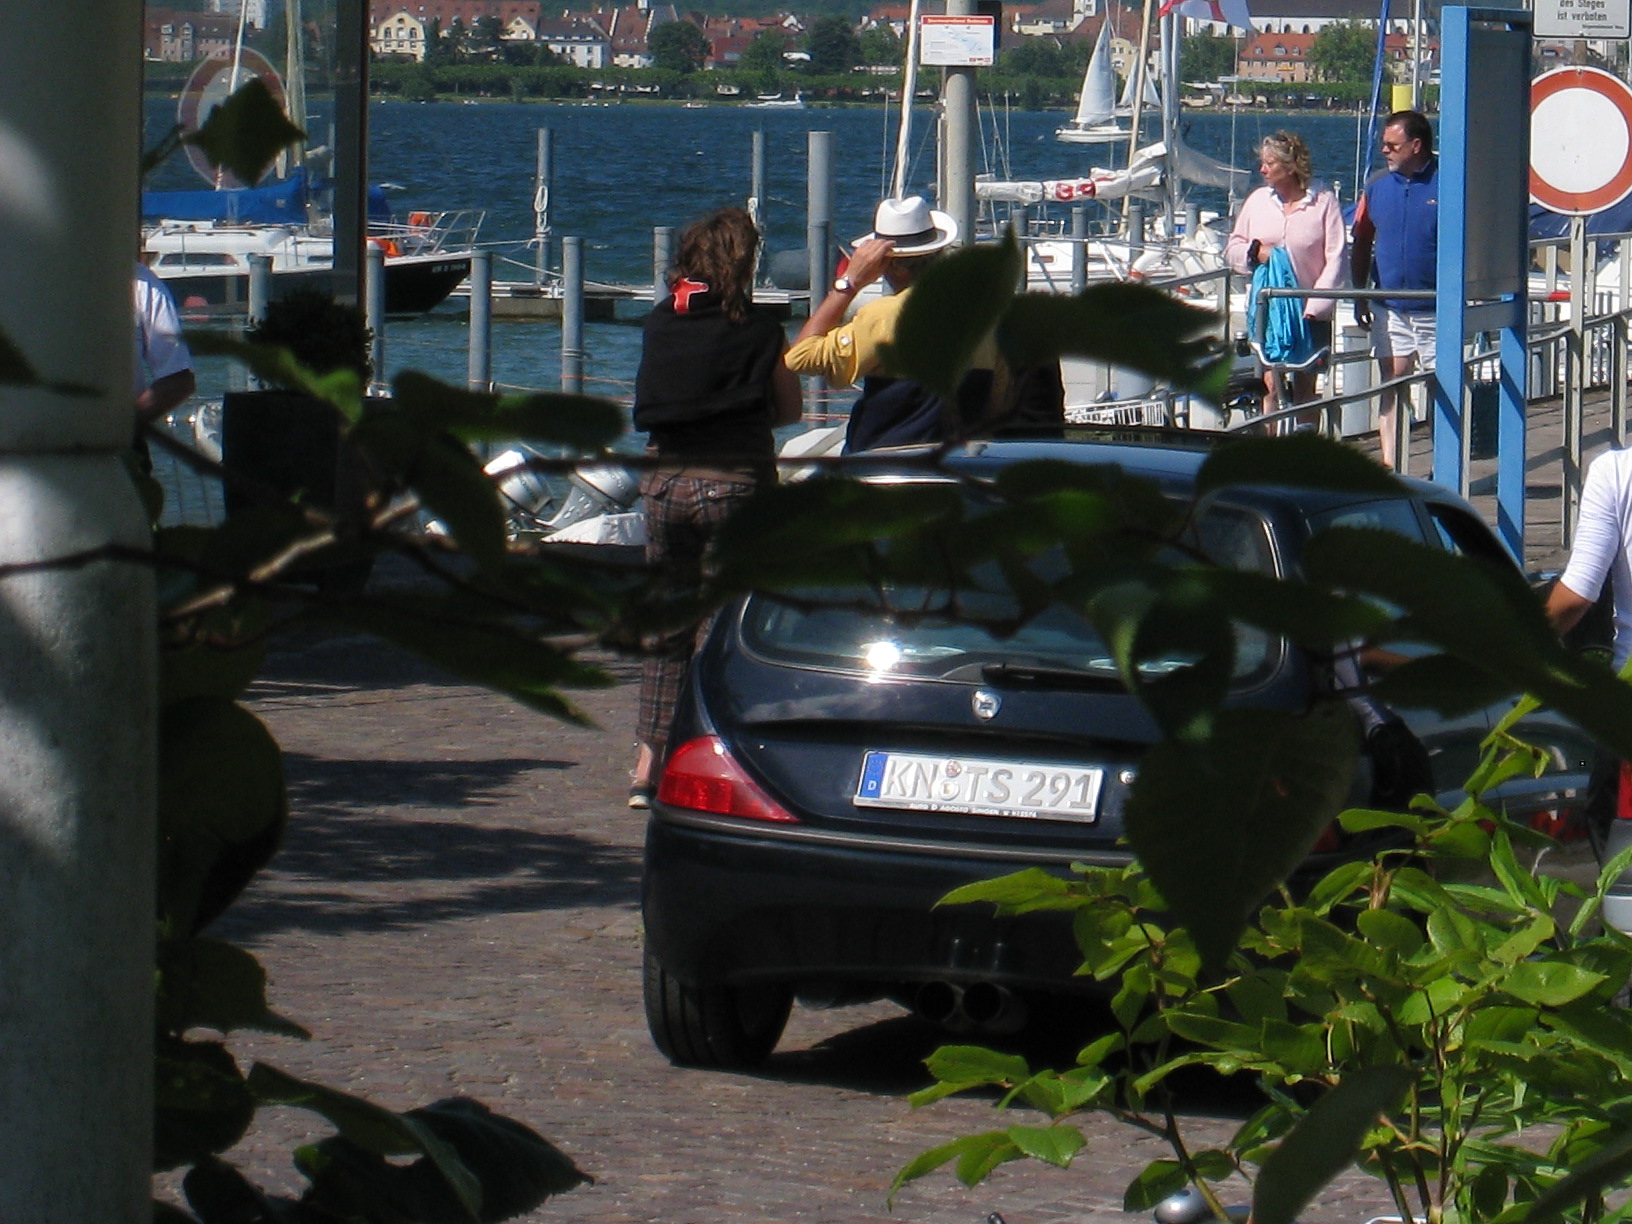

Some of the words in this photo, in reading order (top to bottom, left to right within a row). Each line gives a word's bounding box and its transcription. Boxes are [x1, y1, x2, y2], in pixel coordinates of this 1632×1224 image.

[1557, 11, 1568, 20] ist
[1571, 11, 1608, 21] verboten
[867, 780, 877, 791] D
[885, 760, 939, 799] KN
[965, 767, 1013, 803] TS
[1020, 771, 1093, 809] 291
